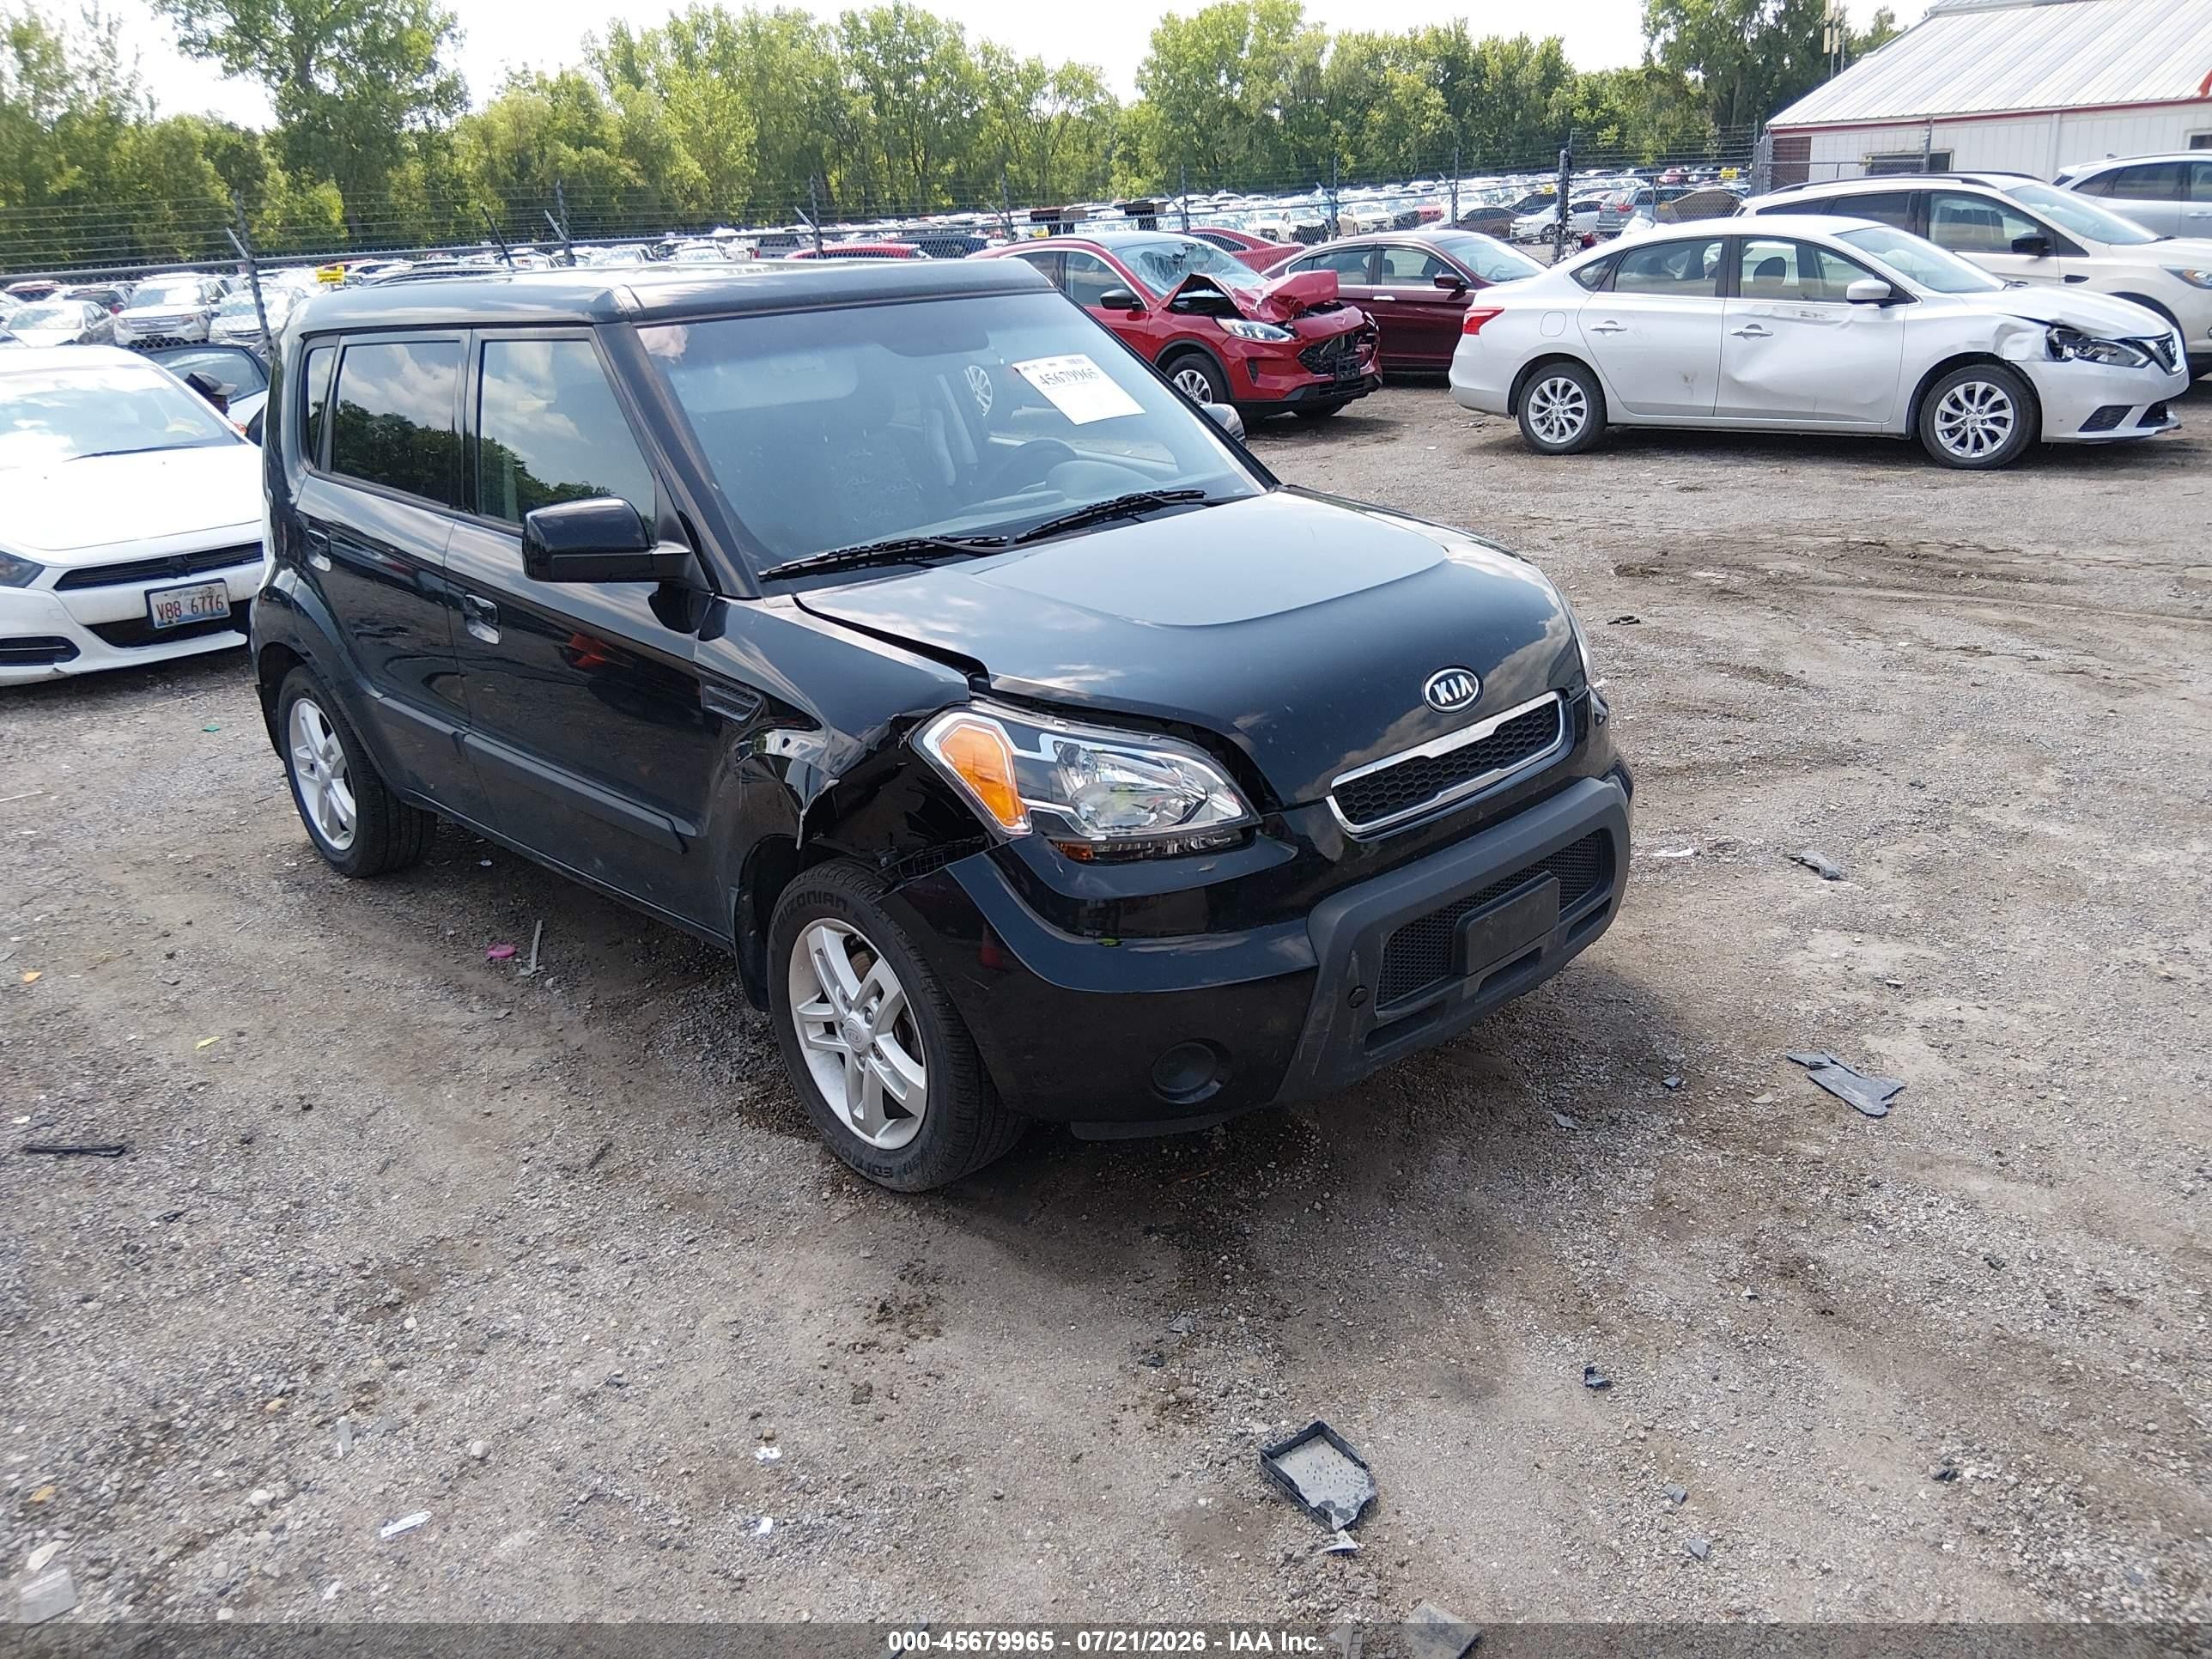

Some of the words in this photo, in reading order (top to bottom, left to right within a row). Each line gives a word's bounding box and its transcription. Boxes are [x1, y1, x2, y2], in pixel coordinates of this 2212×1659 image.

[1038, 368, 1100, 386] 45679965
[155, 600, 182, 621] V88
[191, 594, 224, 615] 6776
[1432, 673, 1474, 705] KIA
